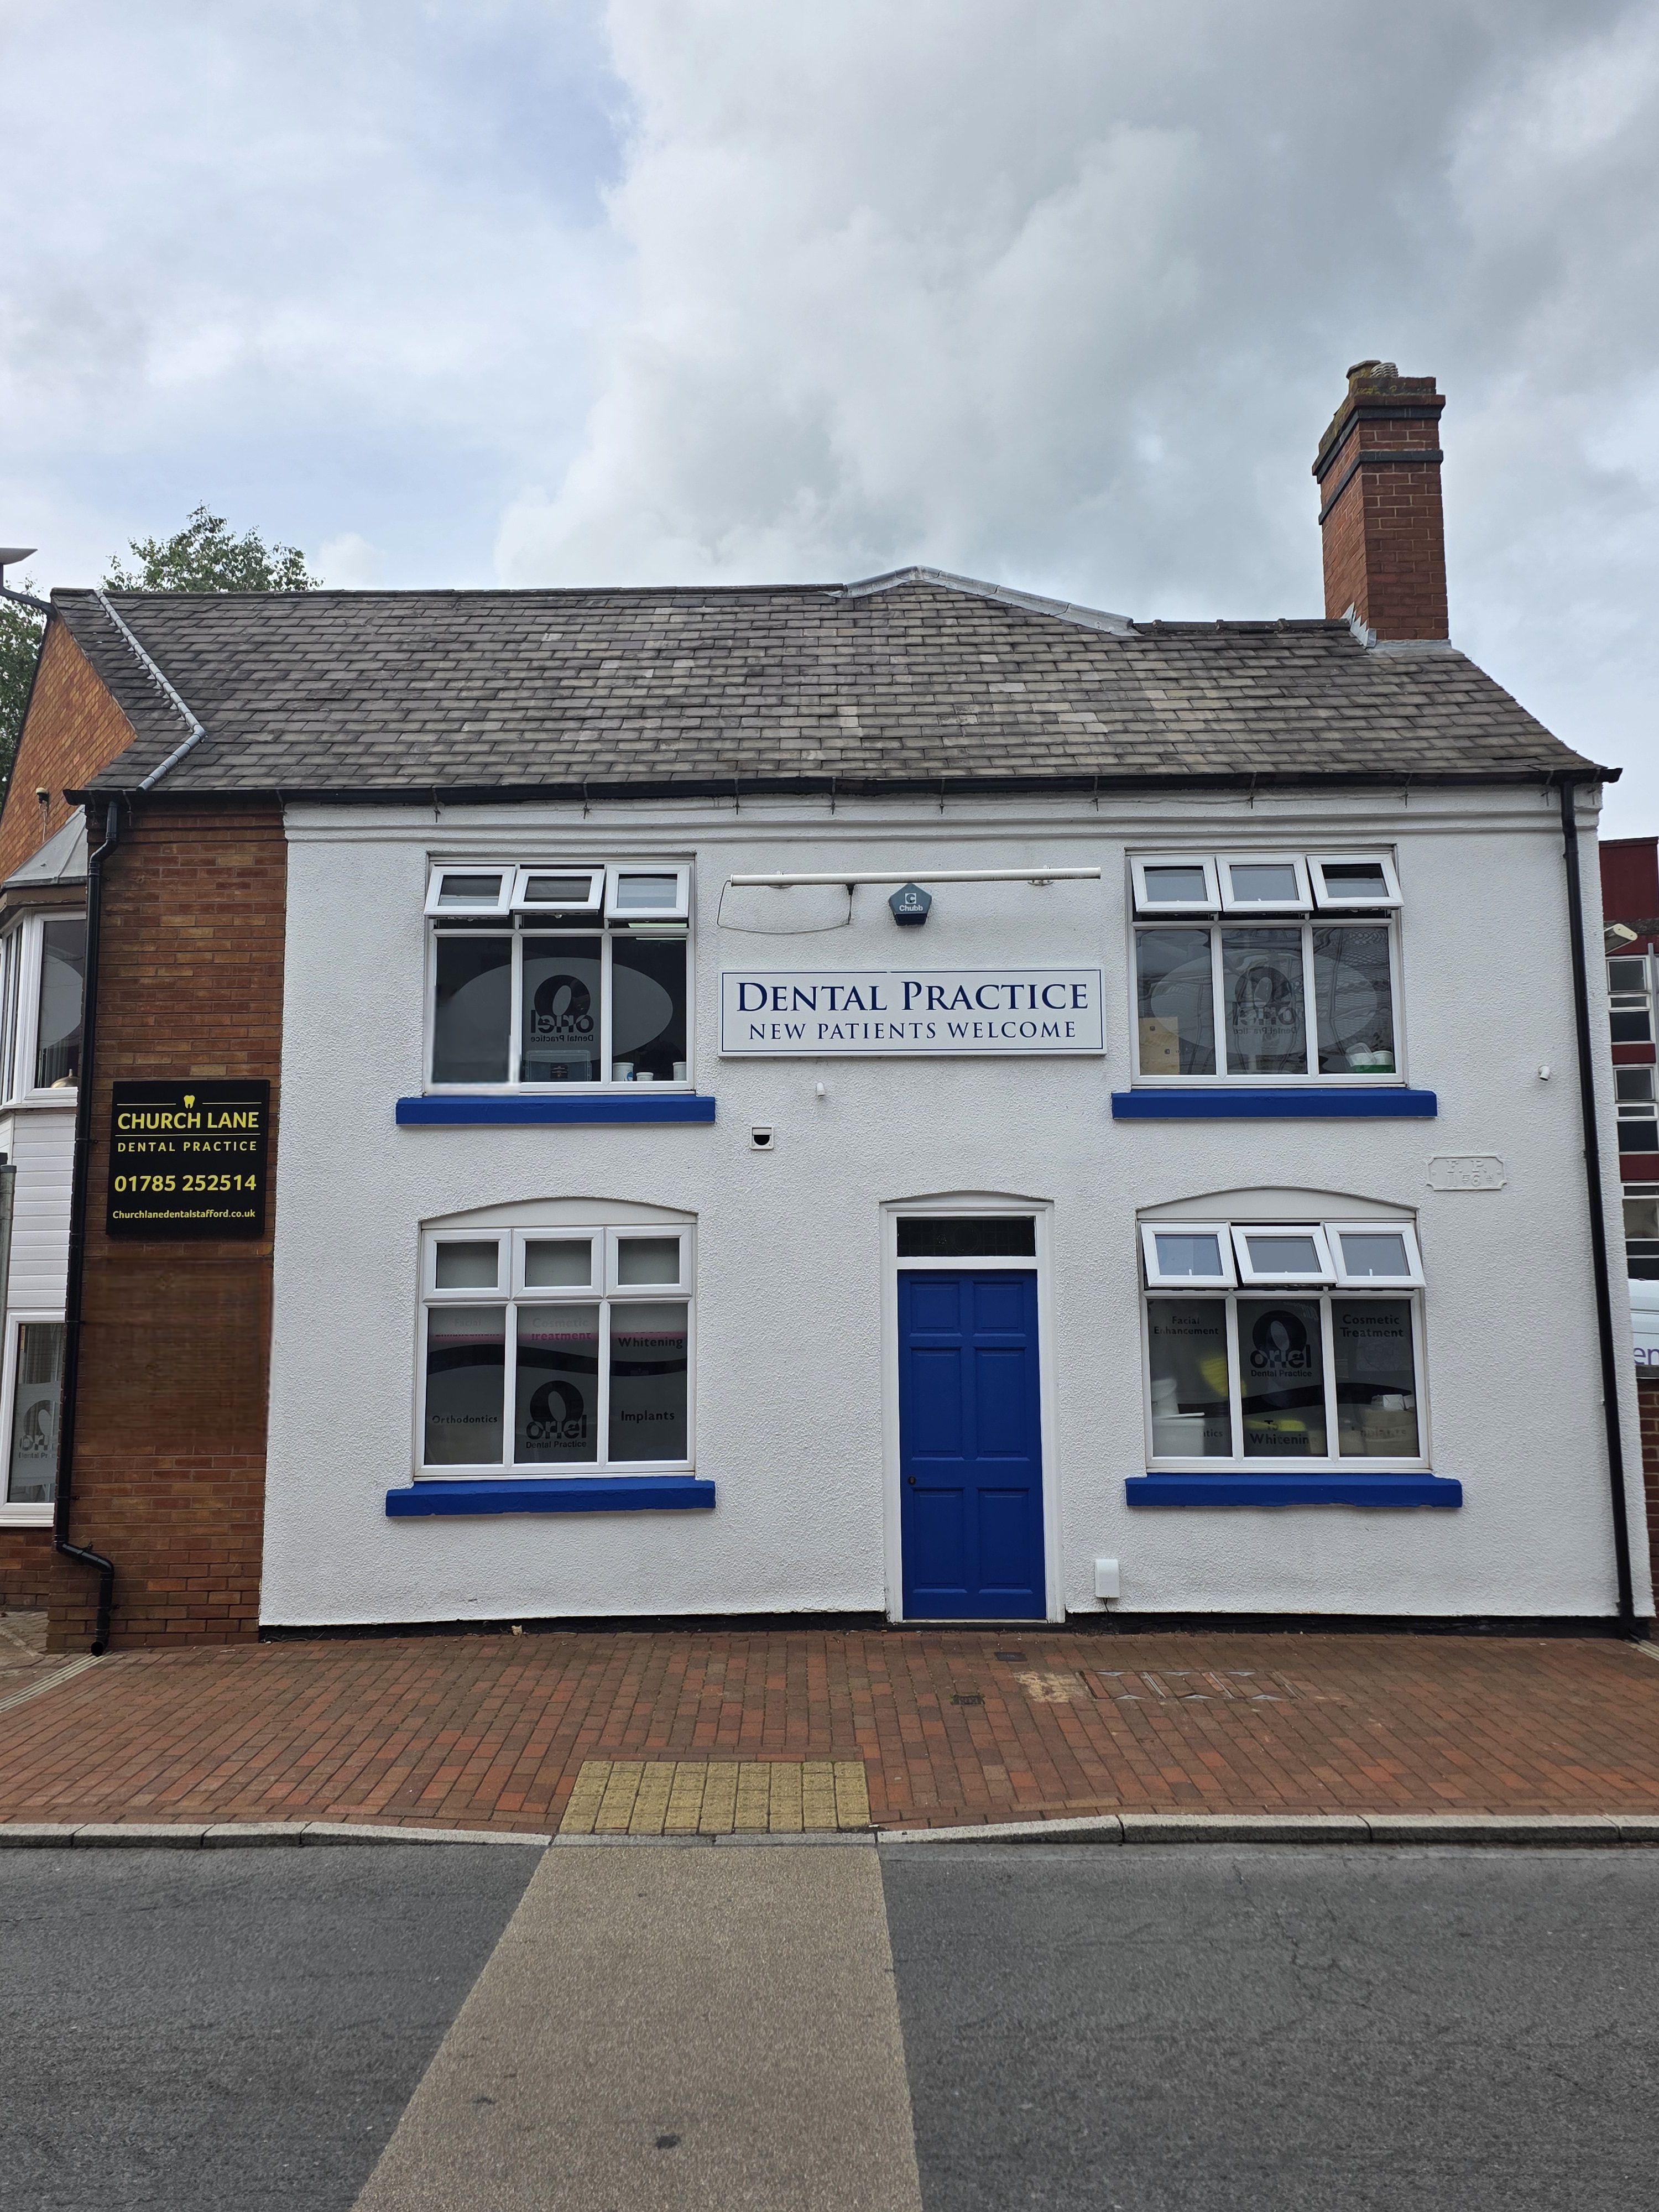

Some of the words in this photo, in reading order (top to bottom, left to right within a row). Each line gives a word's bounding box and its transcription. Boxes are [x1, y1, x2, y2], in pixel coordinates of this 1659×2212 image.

[736, 982, 888, 1011] DENTAL
[901, 981, 1088, 1010] PRACTICE
[749, 1023, 806, 1040] NEW
[817, 1022, 936, 1040] PATIENTS
[947, 1021, 1076, 1039] WELCOME
[118, 1113, 201, 1129] CHURCH
[207, 1112, 259, 1128] LANE
[117, 1142, 175, 1152] DENTAL
[183, 1141, 257, 1151] PRACTICE
[114, 1175, 176, 1192] 01785
[182, 1174, 257, 1191] 252514
[112, 1209, 255, 1219] Churchlanedentalstafford.co.uk
[532, 1317, 589, 1328] Cosmetic
[1172, 1316, 1200, 1324] Facial
[1342, 1314, 1400, 1324] Cosmetic
[1339, 1327, 1404, 1337] Treatment
[618, 1336, 683, 1349] Whitening
[1250, 1344, 1312, 1368] oriel
[432, 1415, 498, 1423] Orthodontics
[621, 1410, 675, 1423] Implants
[526, 1415, 587, 1439] oriel
[1249, 1433, 1309, 1444] Whitenin
